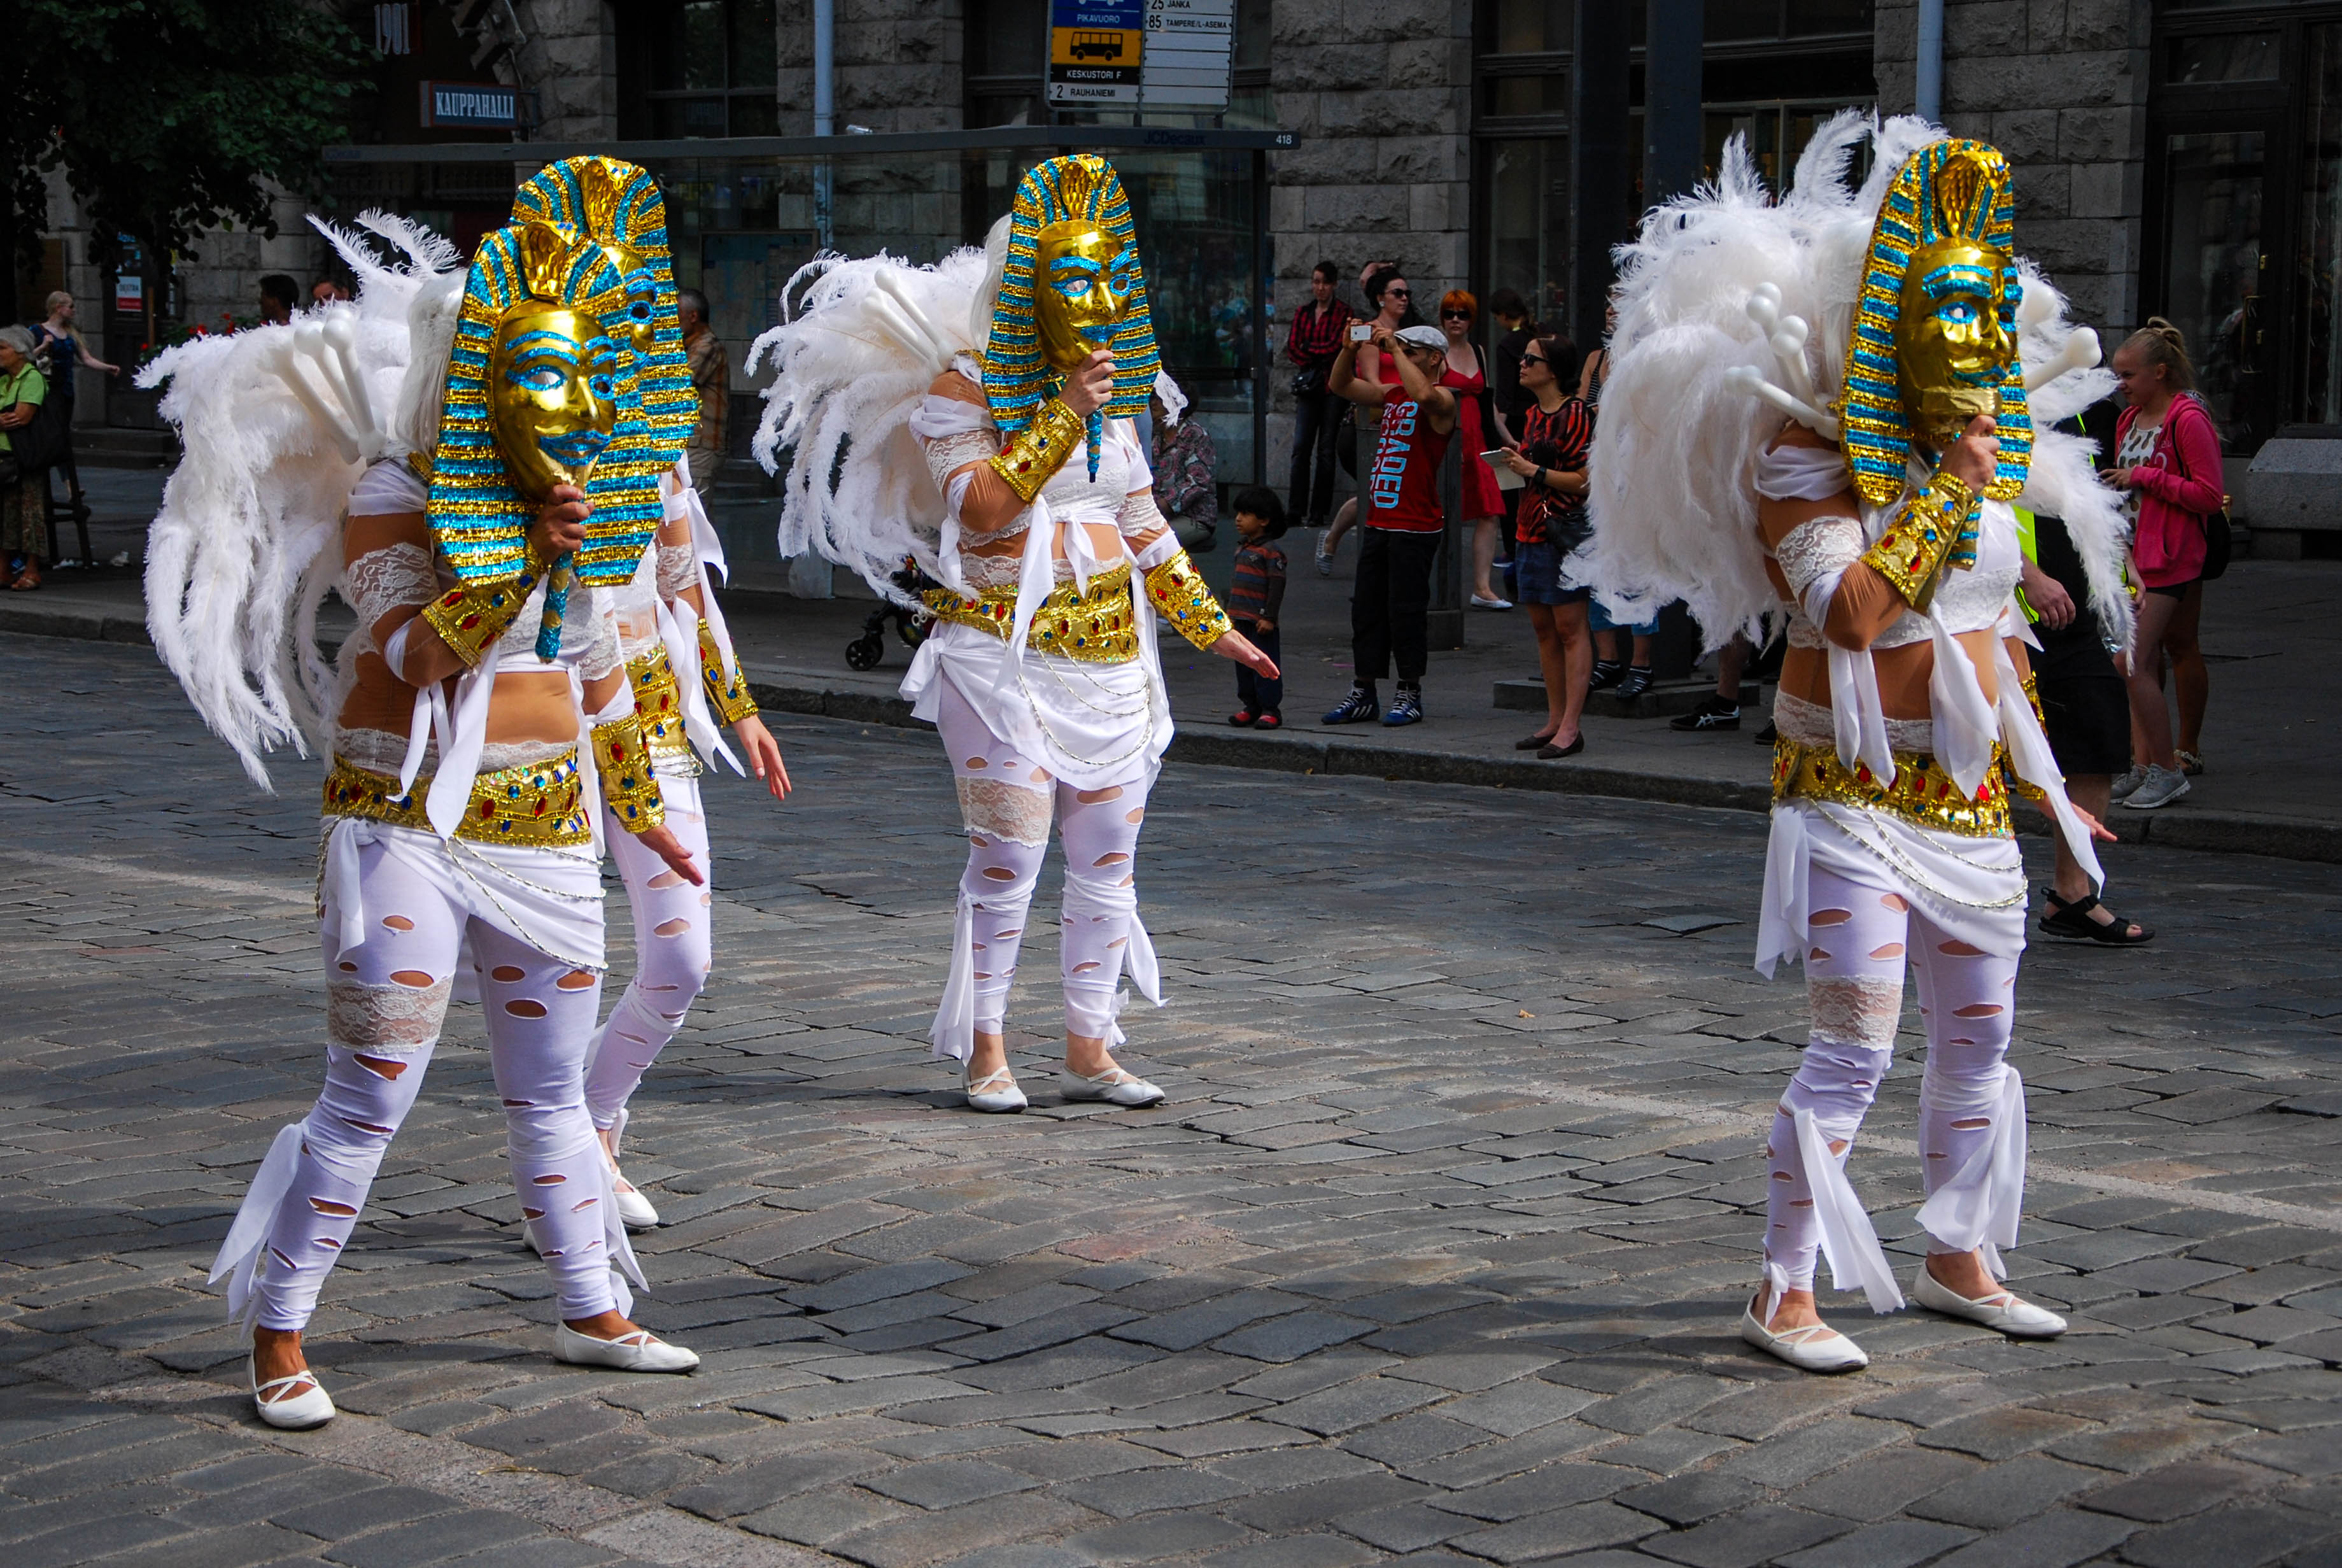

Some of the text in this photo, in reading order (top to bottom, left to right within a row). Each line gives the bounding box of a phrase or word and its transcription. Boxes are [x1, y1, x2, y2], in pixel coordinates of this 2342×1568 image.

[1152, 0, 1164, 10] 25
[1076, 13, 1120, 24] PIKAVUORO
[1150, 15, 1227, 29] 85 TAMPERE/L-ASEMA
[373, 2, 411, 55] 1901
[1066, 69, 1122, 80] KESKUSTORI F
[1057, 85, 1115, 98] 2 RAUHANIEMI
[435, 92, 514, 119] KAUPPAHALLI
[1144, 131, 1206, 146] JCDecaux
[1275, 134, 1293, 145] 418
[1374, 401, 1418, 509] GRADED
